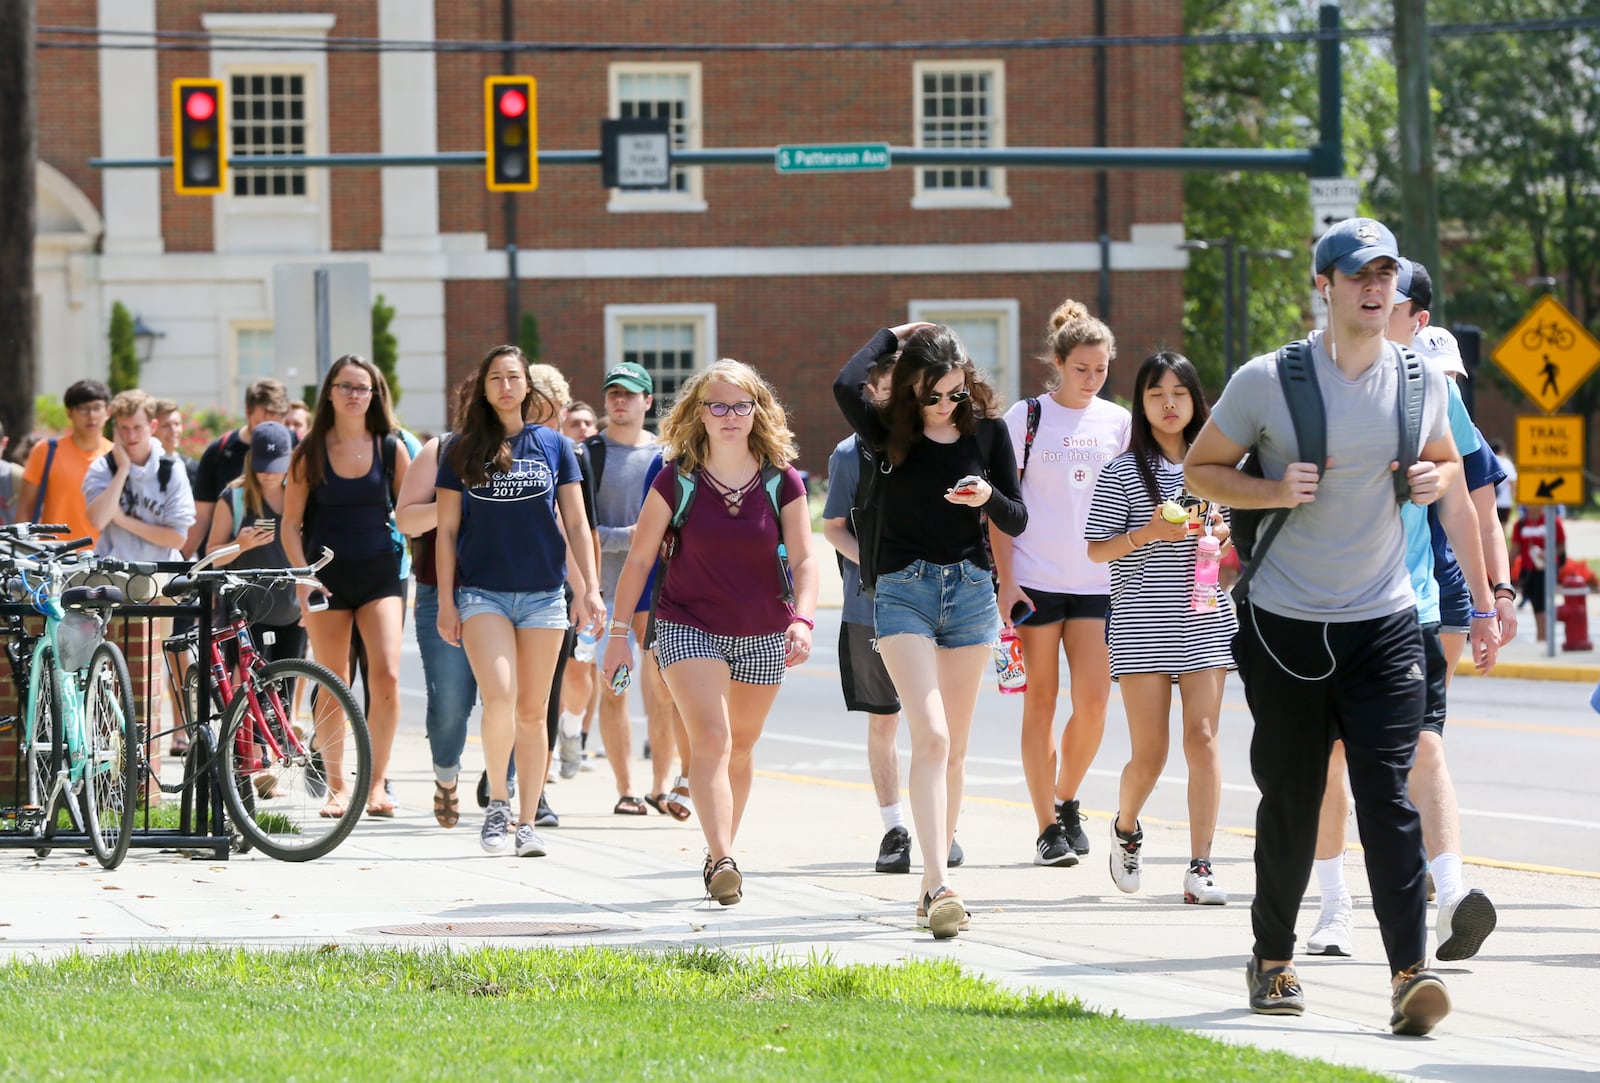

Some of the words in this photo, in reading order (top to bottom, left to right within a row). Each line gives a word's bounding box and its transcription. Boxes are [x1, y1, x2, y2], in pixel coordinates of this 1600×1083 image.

[781, 150, 791, 167] S
[795, 150, 860, 166] Patterson
[861, 149, 887, 163] Ave
[1311, 185, 1359, 198] NORTH
[1529, 426, 1569, 439] TRAIL
[1063, 436, 1098, 447] Shoot
[1042, 449, 1062, 463] for
[1068, 448, 1090, 462] the
[1530, 444, 1569, 457] X-ING
[493, 480, 547, 488] UNIVERSITY
[492, 487, 523, 497] 2017
